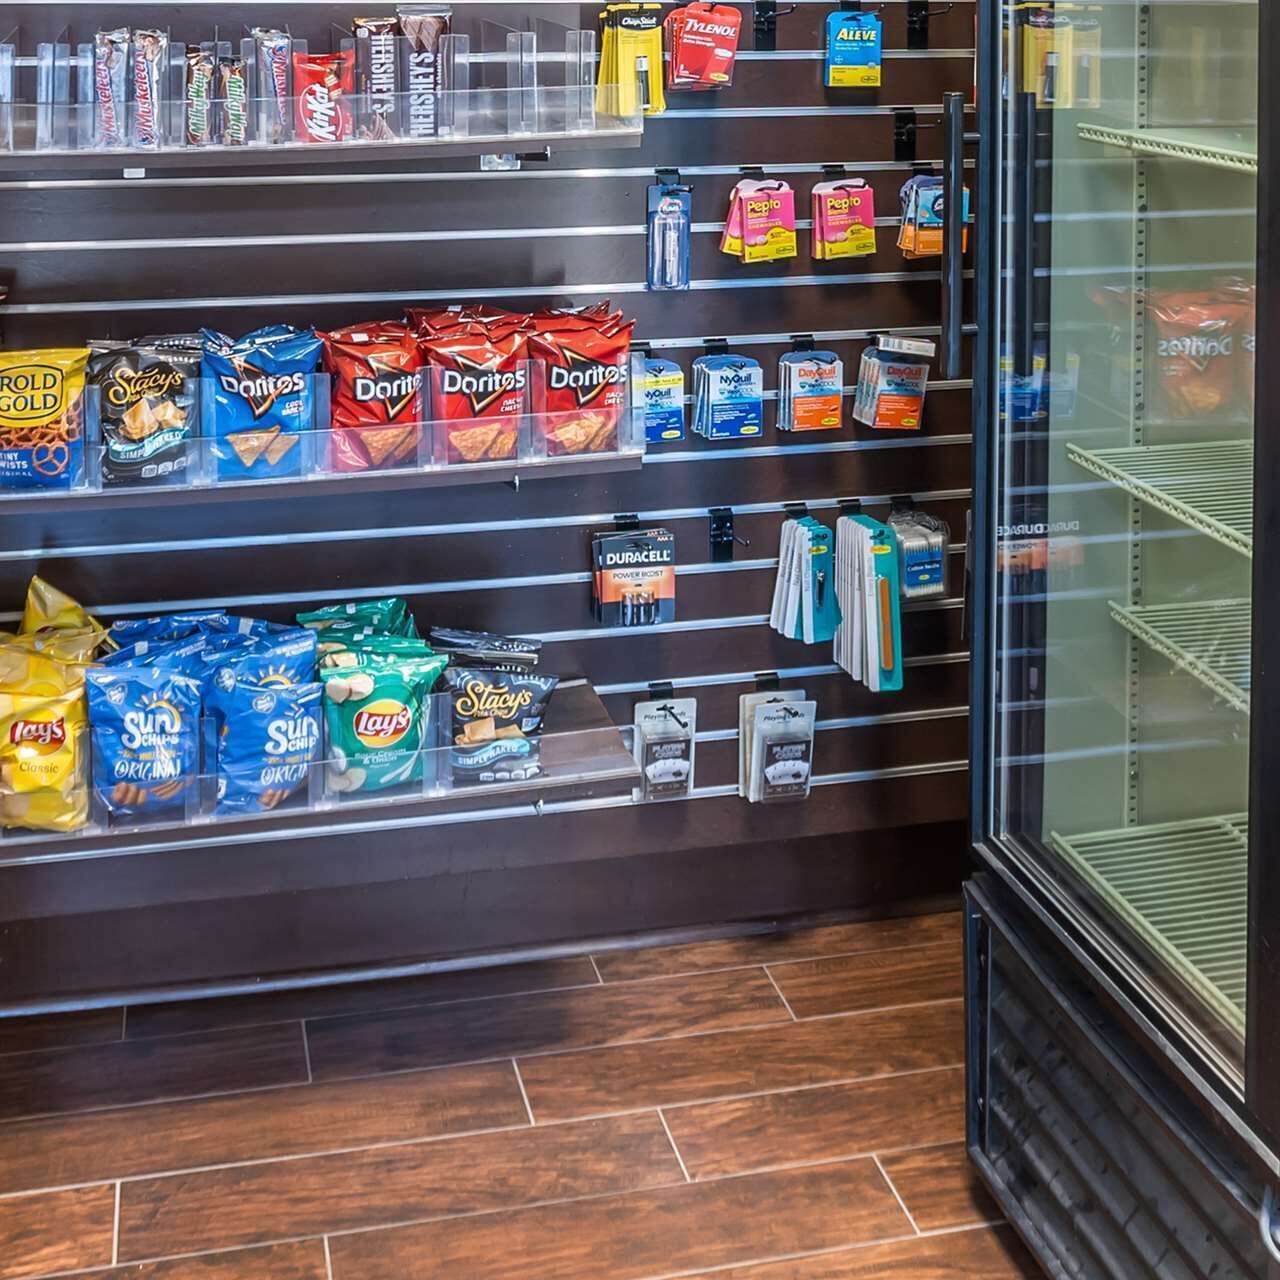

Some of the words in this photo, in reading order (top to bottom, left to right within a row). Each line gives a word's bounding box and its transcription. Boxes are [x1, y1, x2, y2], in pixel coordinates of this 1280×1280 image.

[685, 18, 736, 37] TYLENOL
[836, 28, 877, 41] ALEVE
[409, 52, 436, 138] HERSHEY'S
[747, 199, 781, 213] Pepto
[827, 197, 861, 211] Pepto
[443, 370, 526, 393] Doritos
[550, 365, 628, 389] Doritos
[720, 373, 752, 386] NyQuil
[798, 366, 836, 378] DayQuil
[108, 367, 184, 405] Stacy's
[220, 372, 305, 398] Doritos
[606, 550, 670, 565] DURACELL
[613, 571, 641, 579] POWER
[456, 680, 533, 719] Stacy's
[13, 719, 65, 745] Lay's
[121, 710, 181, 750] Sun
[358, 710, 410, 737] Lay's
[264, 716, 319, 754] Sun
[287, 736, 318, 752] CHIP
[19, 761, 59, 775] Classic
